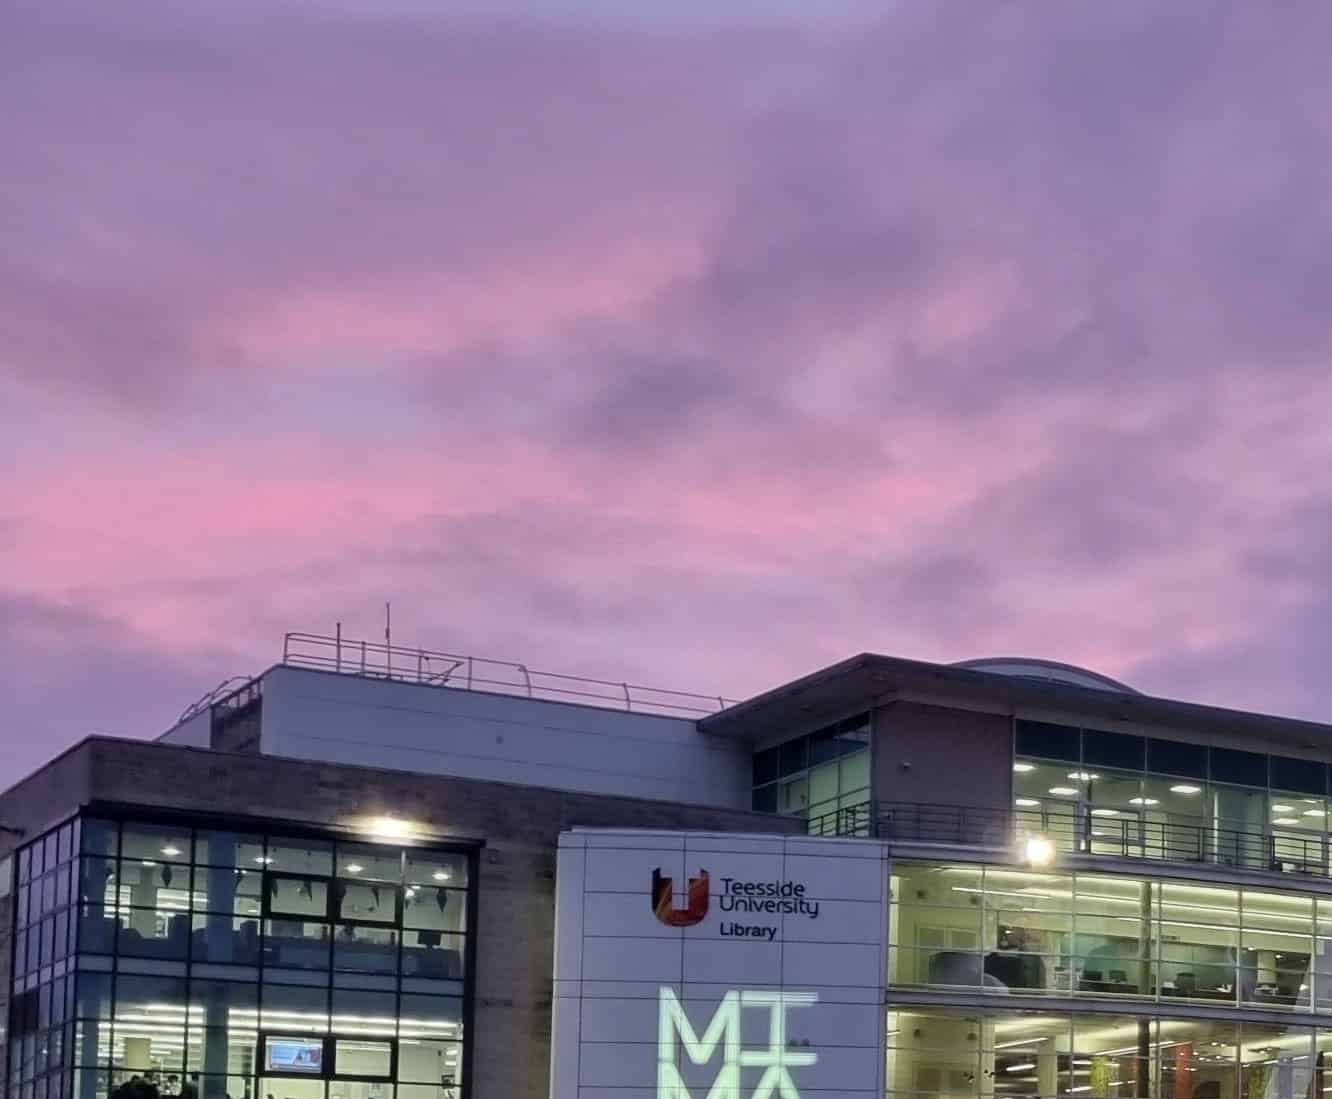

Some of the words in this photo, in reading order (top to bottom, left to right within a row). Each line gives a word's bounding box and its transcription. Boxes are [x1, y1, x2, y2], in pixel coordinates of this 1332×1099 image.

[720, 878, 805, 897] Teesside
[720, 895, 819, 918] University
[720, 921, 777, 941] Library
